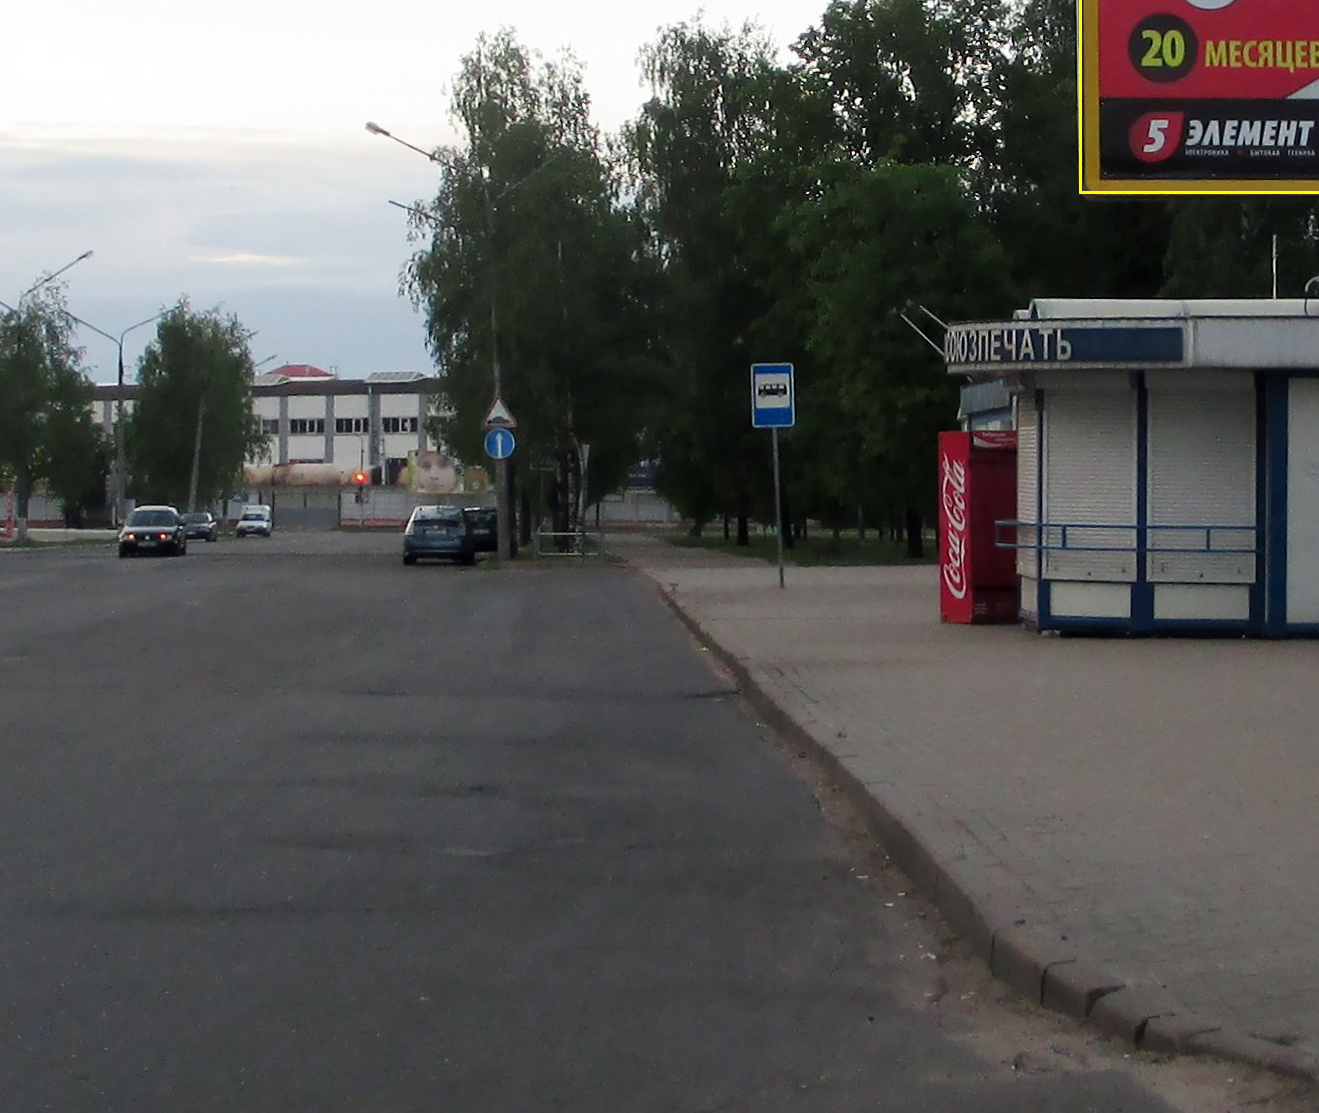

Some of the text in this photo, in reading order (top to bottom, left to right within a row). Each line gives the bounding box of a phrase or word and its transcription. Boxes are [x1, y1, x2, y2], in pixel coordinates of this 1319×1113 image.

[1140, 30, 1185, 68] 20
[1142, 119, 1169, 153] 5
[1185, 119, 1315, 147] ЭЛЕМЕНТ
